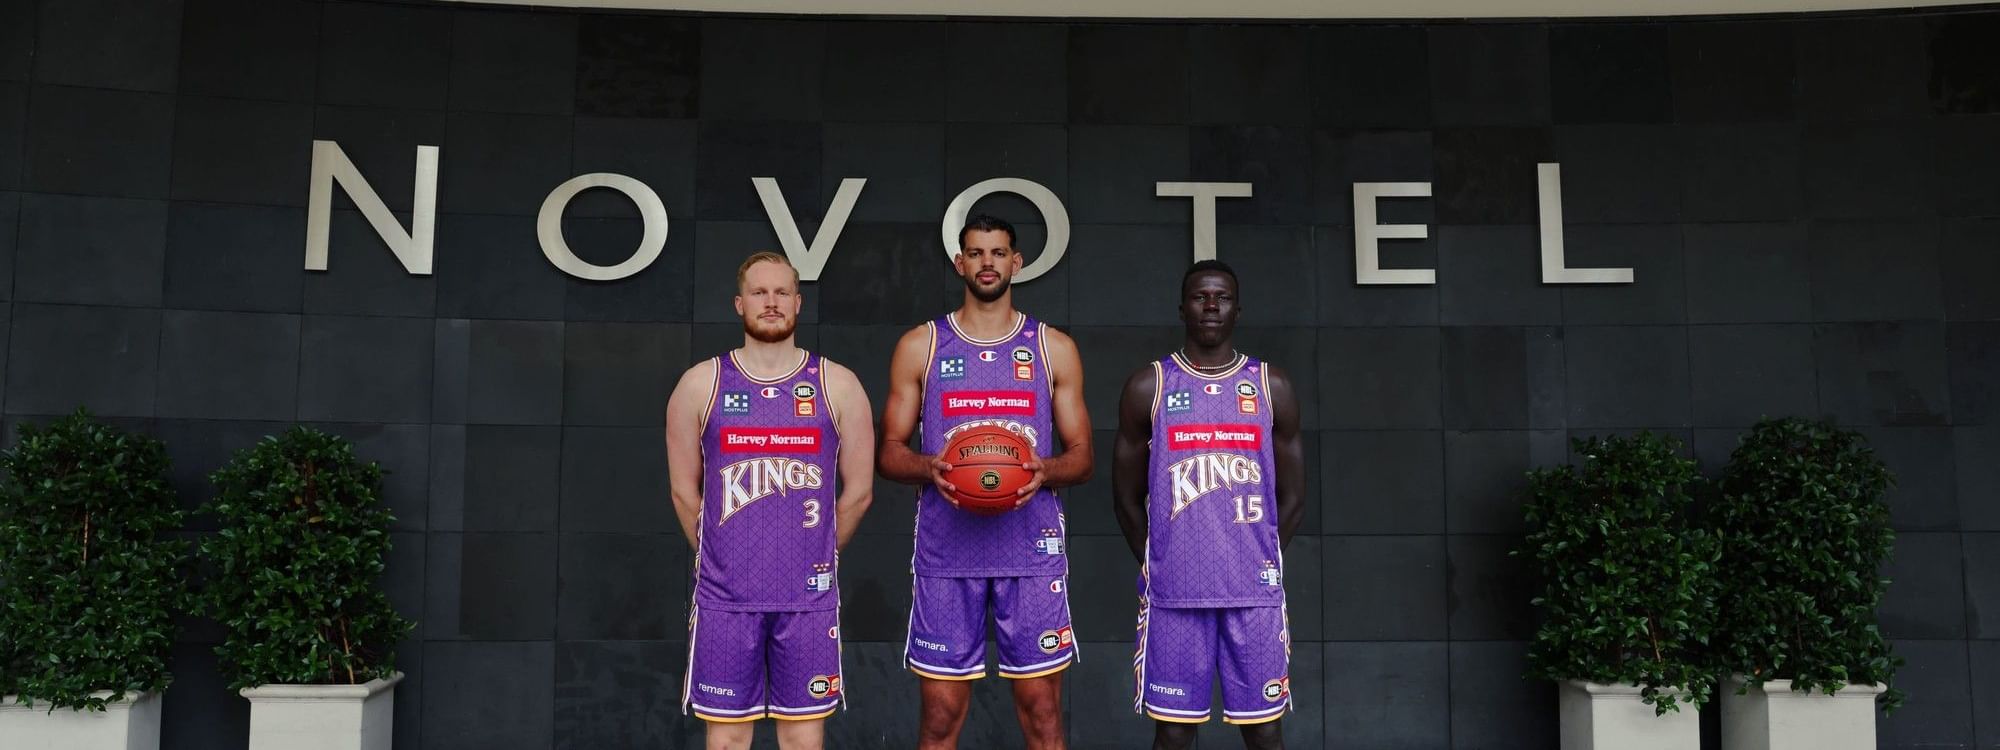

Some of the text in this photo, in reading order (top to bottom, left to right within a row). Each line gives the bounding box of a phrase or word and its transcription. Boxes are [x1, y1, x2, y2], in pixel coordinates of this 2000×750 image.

[304, 140, 1634, 285] NOVOTEL
[948, 397, 1030, 409] Harvey Norman
[727, 434, 814, 446] Harvey Norman
[1175, 431, 1255, 443] Harvey Norman
[958, 444, 1020, 461] SPALDING
[719, 457, 822, 527] KINGS
[1168, 452, 1262, 520] KINGS
[802, 498, 821, 528] 3
[1232, 494, 1264, 523] 15
